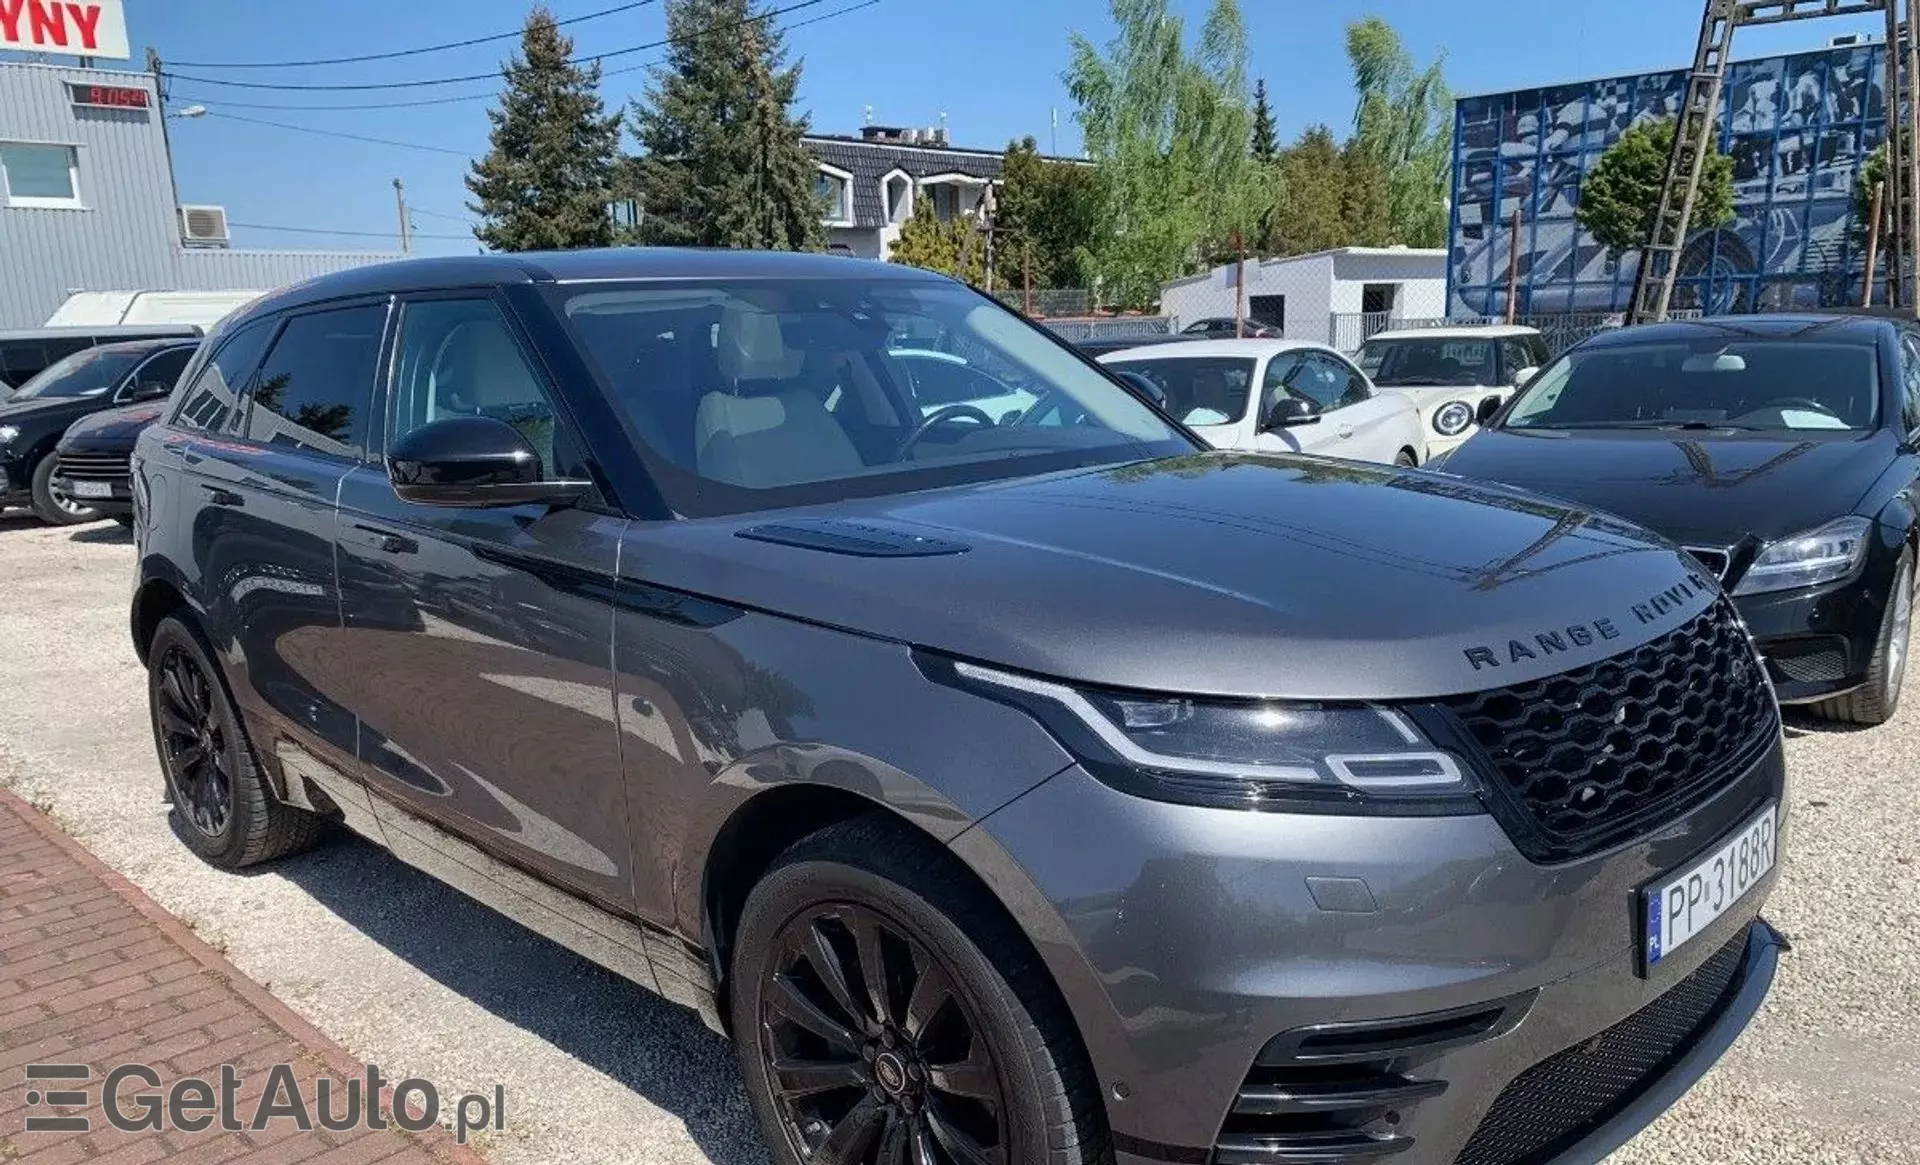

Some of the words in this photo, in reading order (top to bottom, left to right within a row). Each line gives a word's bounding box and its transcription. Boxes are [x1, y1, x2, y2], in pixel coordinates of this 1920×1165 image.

[1464, 617, 1620, 670] RANGE
[1669, 873, 1702, 945] PP
[1713, 817, 1771, 912] 3188R
[1649, 934, 1659, 952] PL
